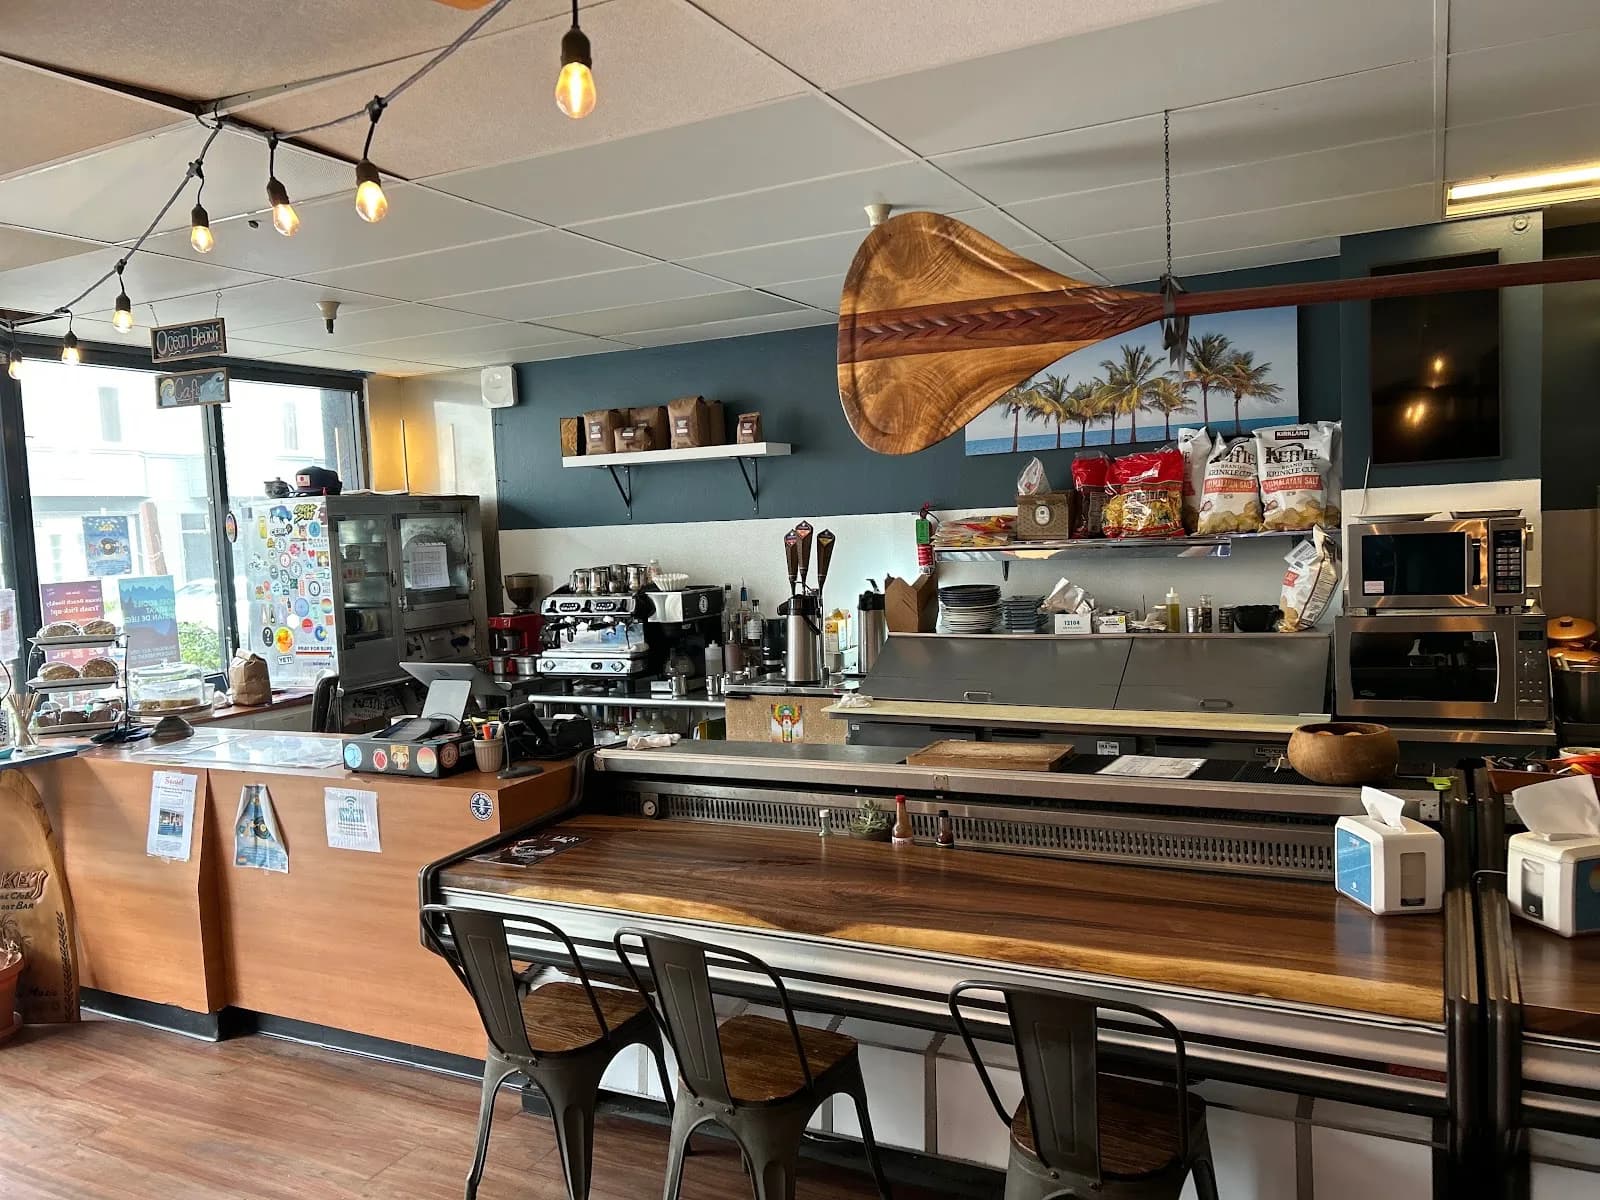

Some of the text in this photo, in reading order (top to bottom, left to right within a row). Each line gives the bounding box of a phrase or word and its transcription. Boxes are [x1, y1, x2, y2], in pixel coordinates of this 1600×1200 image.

[156, 325, 219, 354] Ocean Beach
[1263, 443, 1320, 464] KETTLE
[1281, 462, 1303, 470] BRAND
[1266, 468, 1301, 478] KRINKLE
[1239, 480, 1253, 489] SALT
[1304, 476, 1320, 485] SALT
[16, 901, 34, 910] BAR
